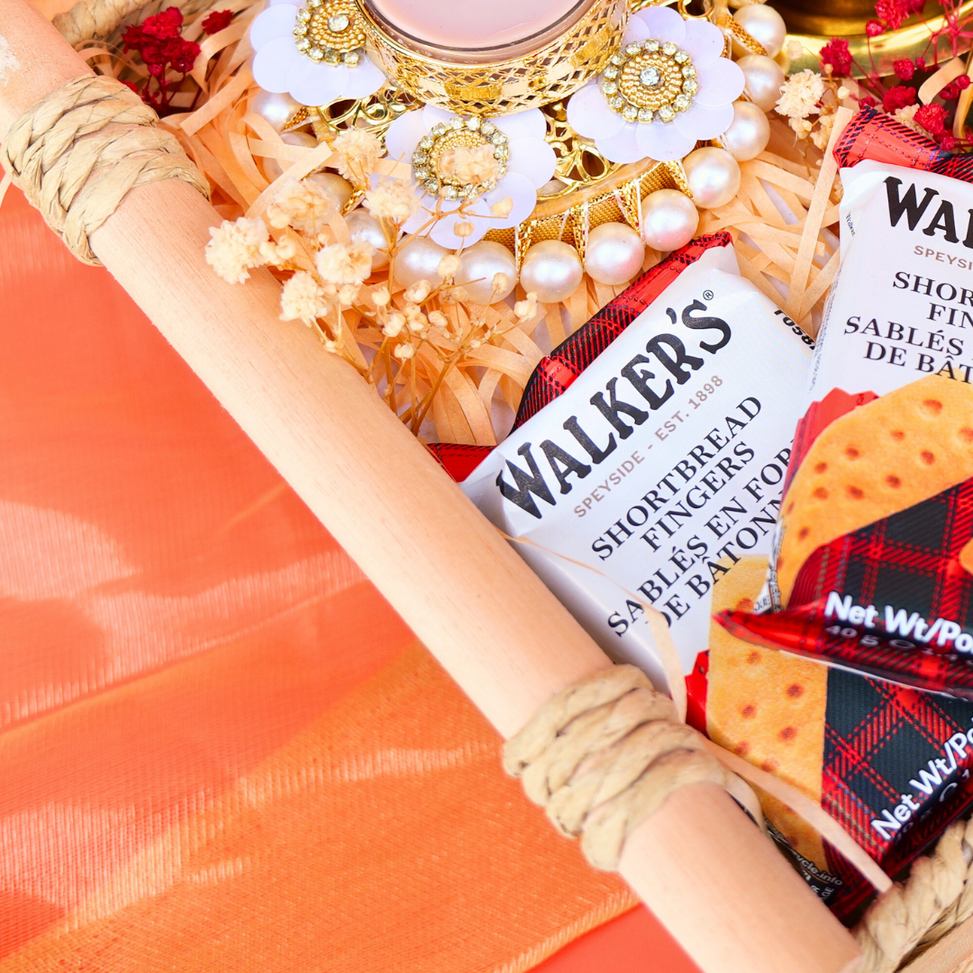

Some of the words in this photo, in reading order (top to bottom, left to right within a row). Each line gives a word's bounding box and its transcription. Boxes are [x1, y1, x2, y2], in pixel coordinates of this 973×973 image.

[844, 315, 963, 357] SABLÉS
[863, 340, 907, 367] DE
[573, 450, 646, 518] SPEYSIDE
[655, 410, 690, 442] EST.
[689, 374, 724, 409] 1898
[591, 396, 762, 561] SHORTBREAD
[639, 441, 756, 552] FINGERS
[607, 535, 709, 638] SABLÉS
[704, 496, 747, 540] EN
[824, 590, 878, 628] Net
[824, 625, 857, 638] 40
[871, 794, 920, 840] Net
